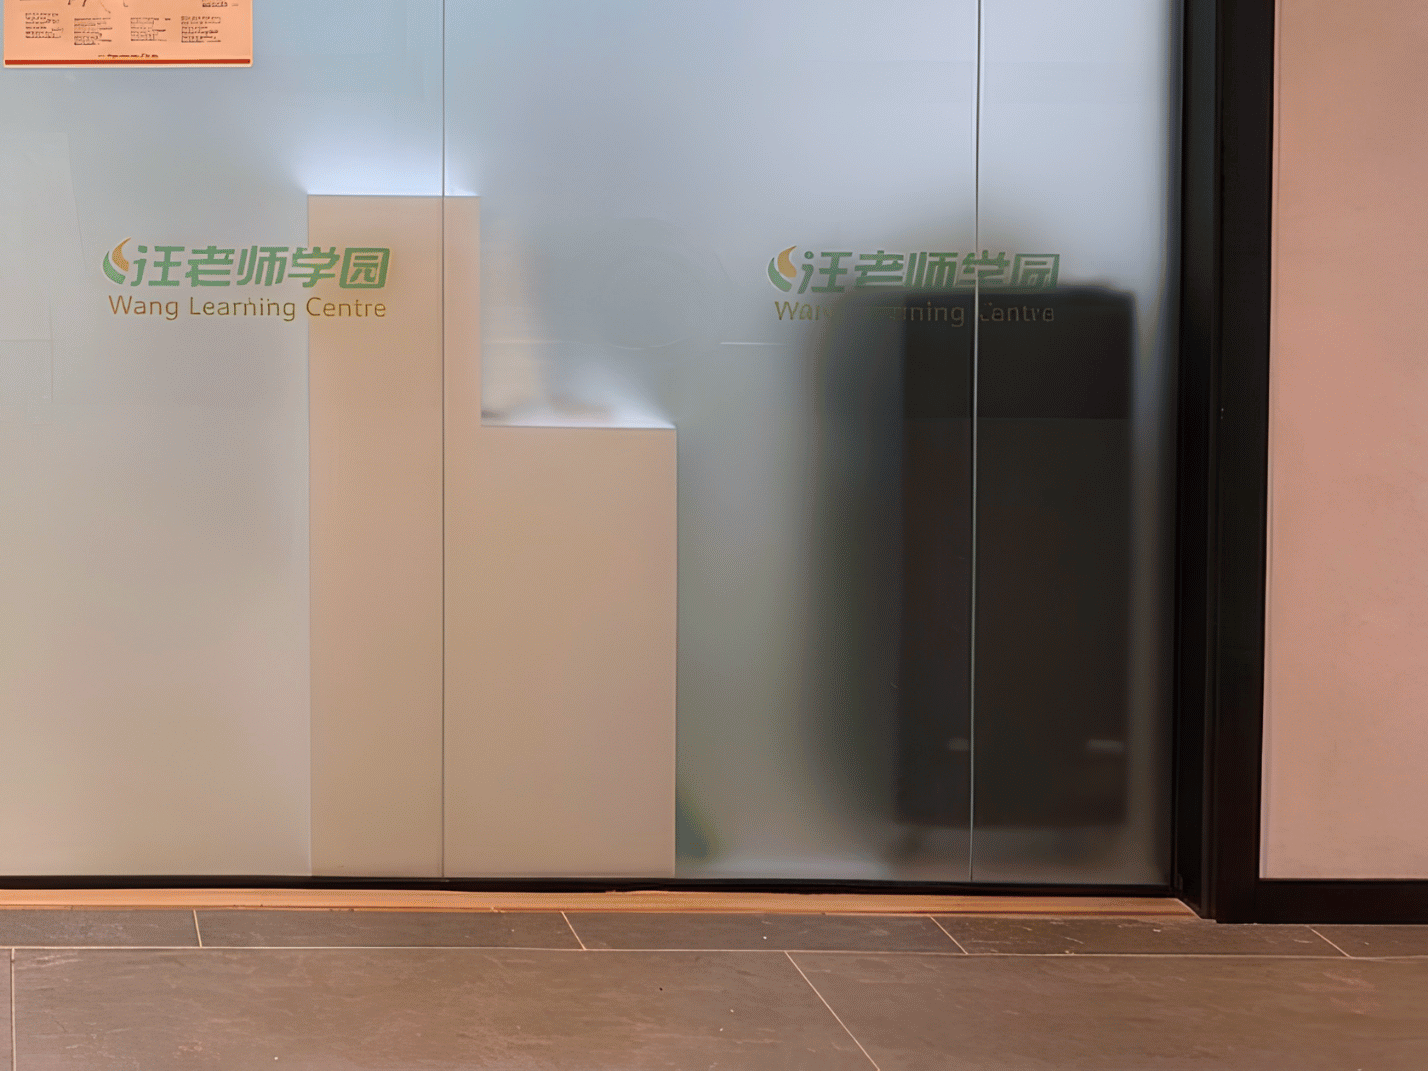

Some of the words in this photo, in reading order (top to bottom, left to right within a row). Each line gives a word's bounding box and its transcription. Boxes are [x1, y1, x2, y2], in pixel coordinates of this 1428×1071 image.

[130, 245, 391, 288] 汪老师学园
[108, 295, 178, 320] Wang
[189, 297, 295, 321] Learning
[306, 297, 386, 317] Centre
